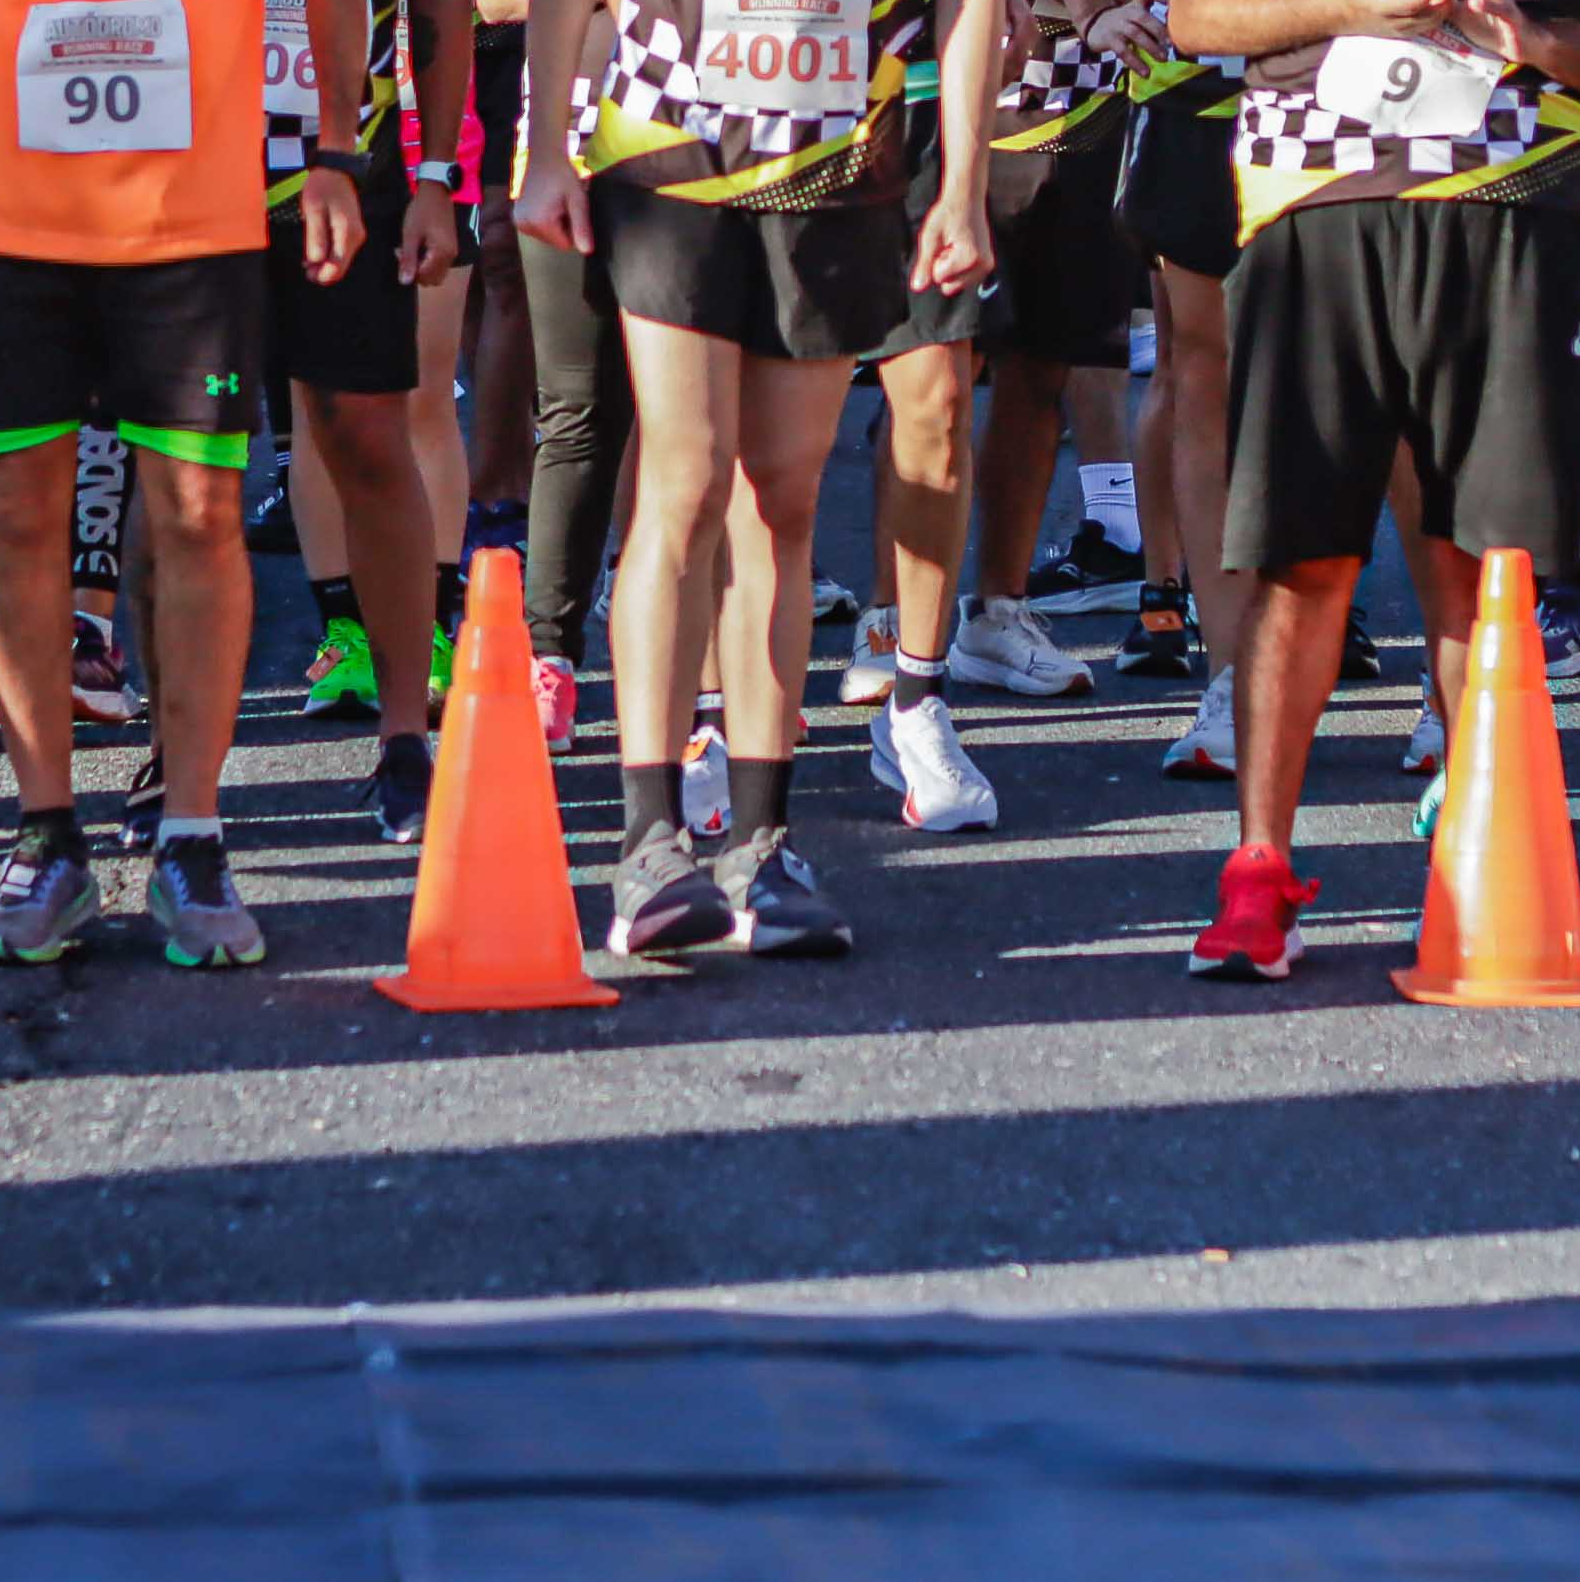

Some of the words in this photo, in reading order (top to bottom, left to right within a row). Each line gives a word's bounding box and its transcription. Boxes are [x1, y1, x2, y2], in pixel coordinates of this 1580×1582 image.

[706, 33, 857, 83] 4001
[1381, 57, 1422, 102] 9
[64, 75, 140, 125] 90
